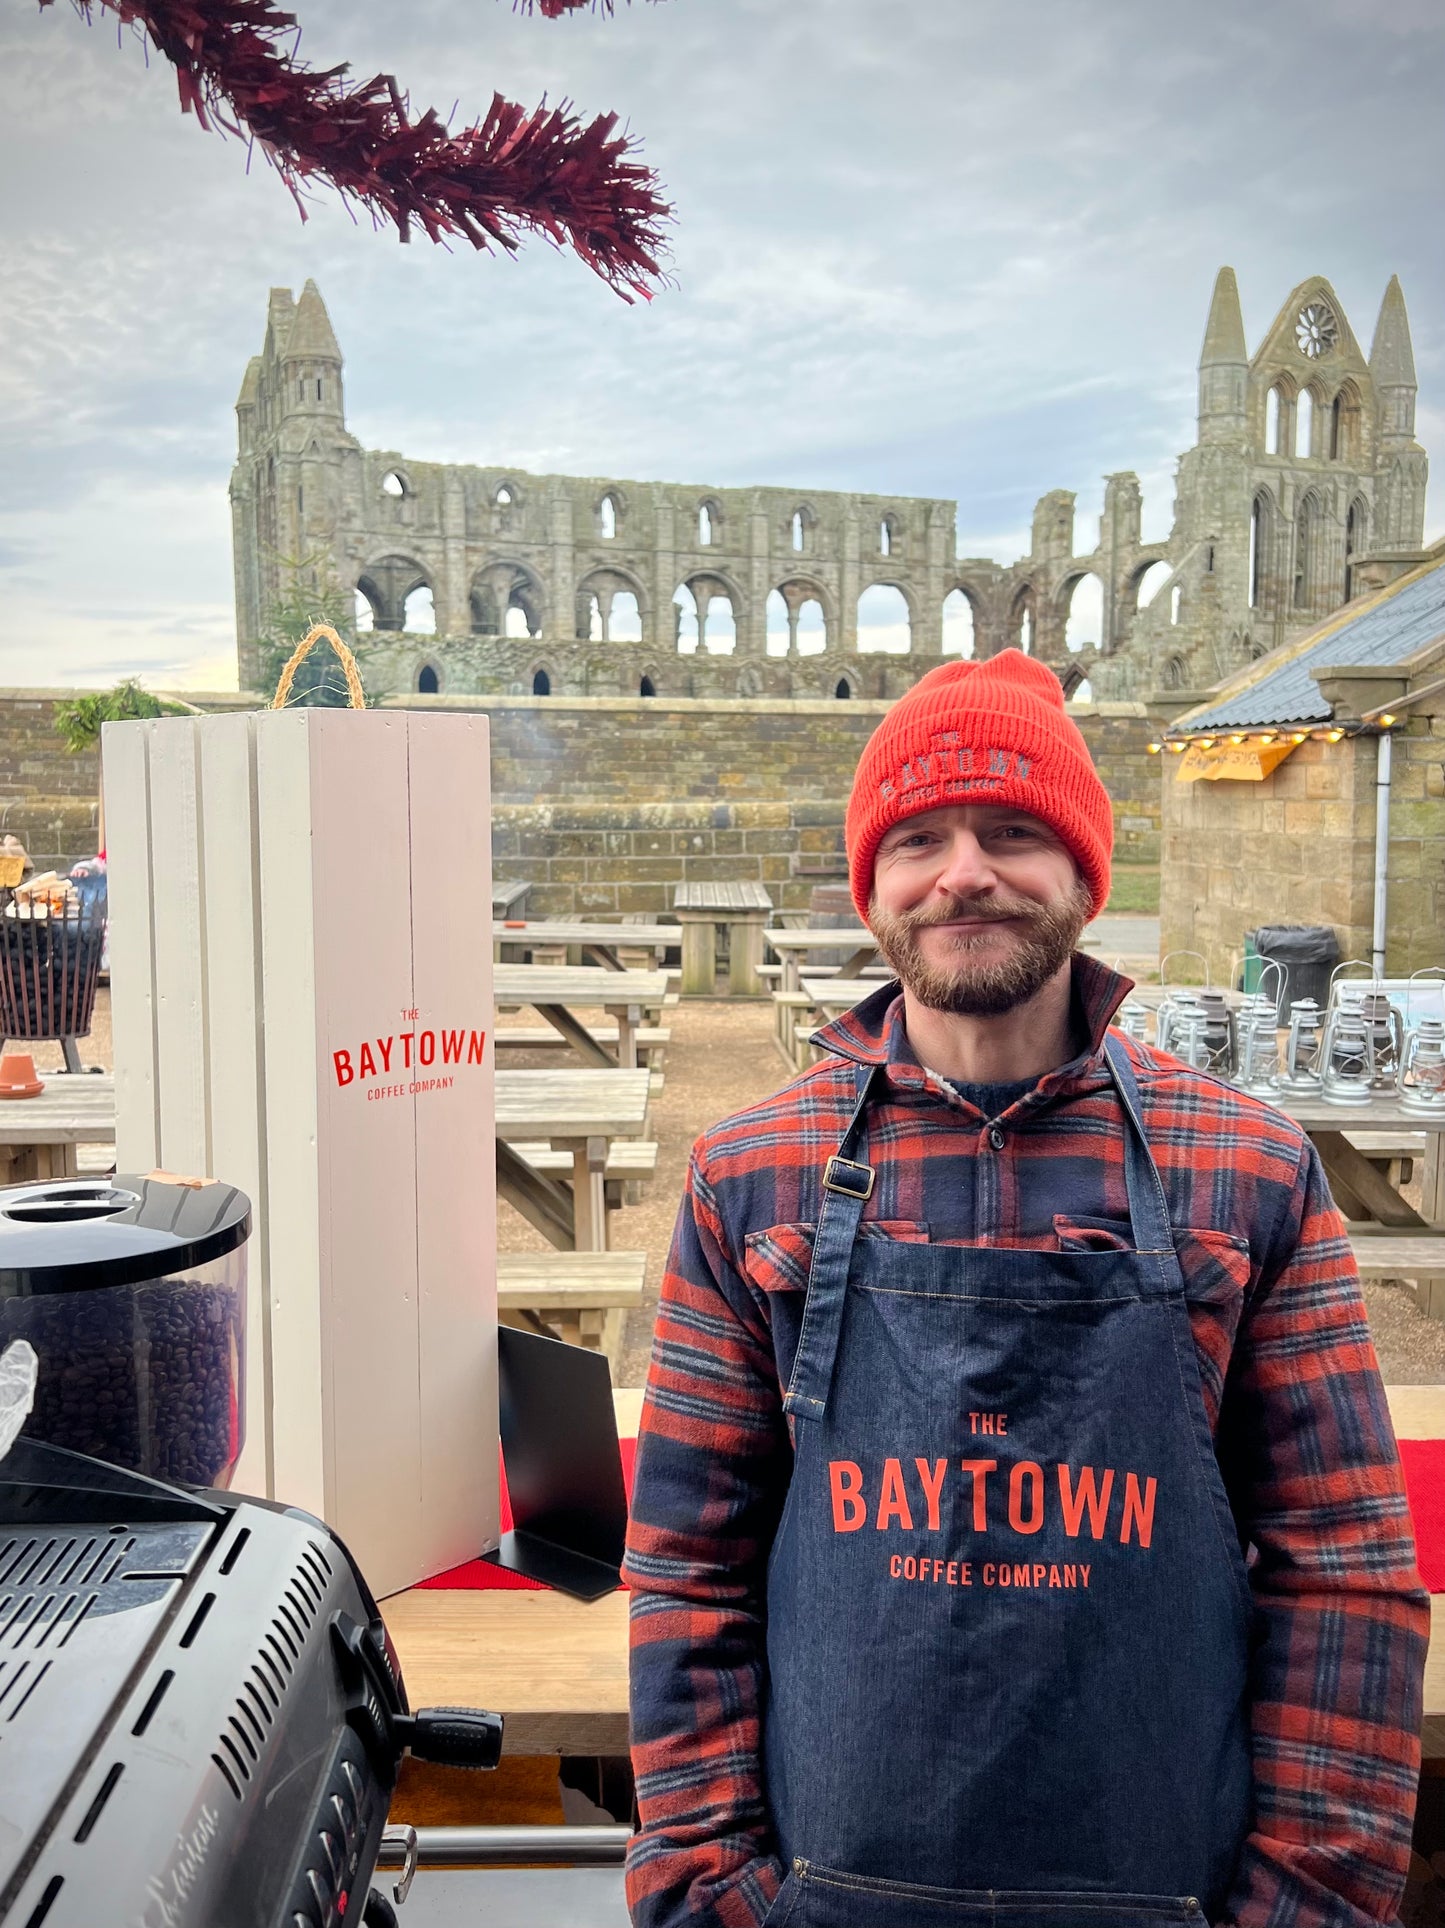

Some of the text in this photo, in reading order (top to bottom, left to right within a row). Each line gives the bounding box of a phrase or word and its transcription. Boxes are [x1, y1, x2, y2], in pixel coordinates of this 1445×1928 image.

[879, 748, 1033, 800] BAYTOWN
[402, 1008, 420, 1021] THE
[333, 1029, 486, 1087] BAYTOWN
[367, 1076, 454, 1101] COFFEE COMPANY
[969, 1412, 1008, 1436] THE
[829, 1457, 1157, 1548] BAYTOWN
[890, 1555, 1092, 1588] COFFEE COMPANY
